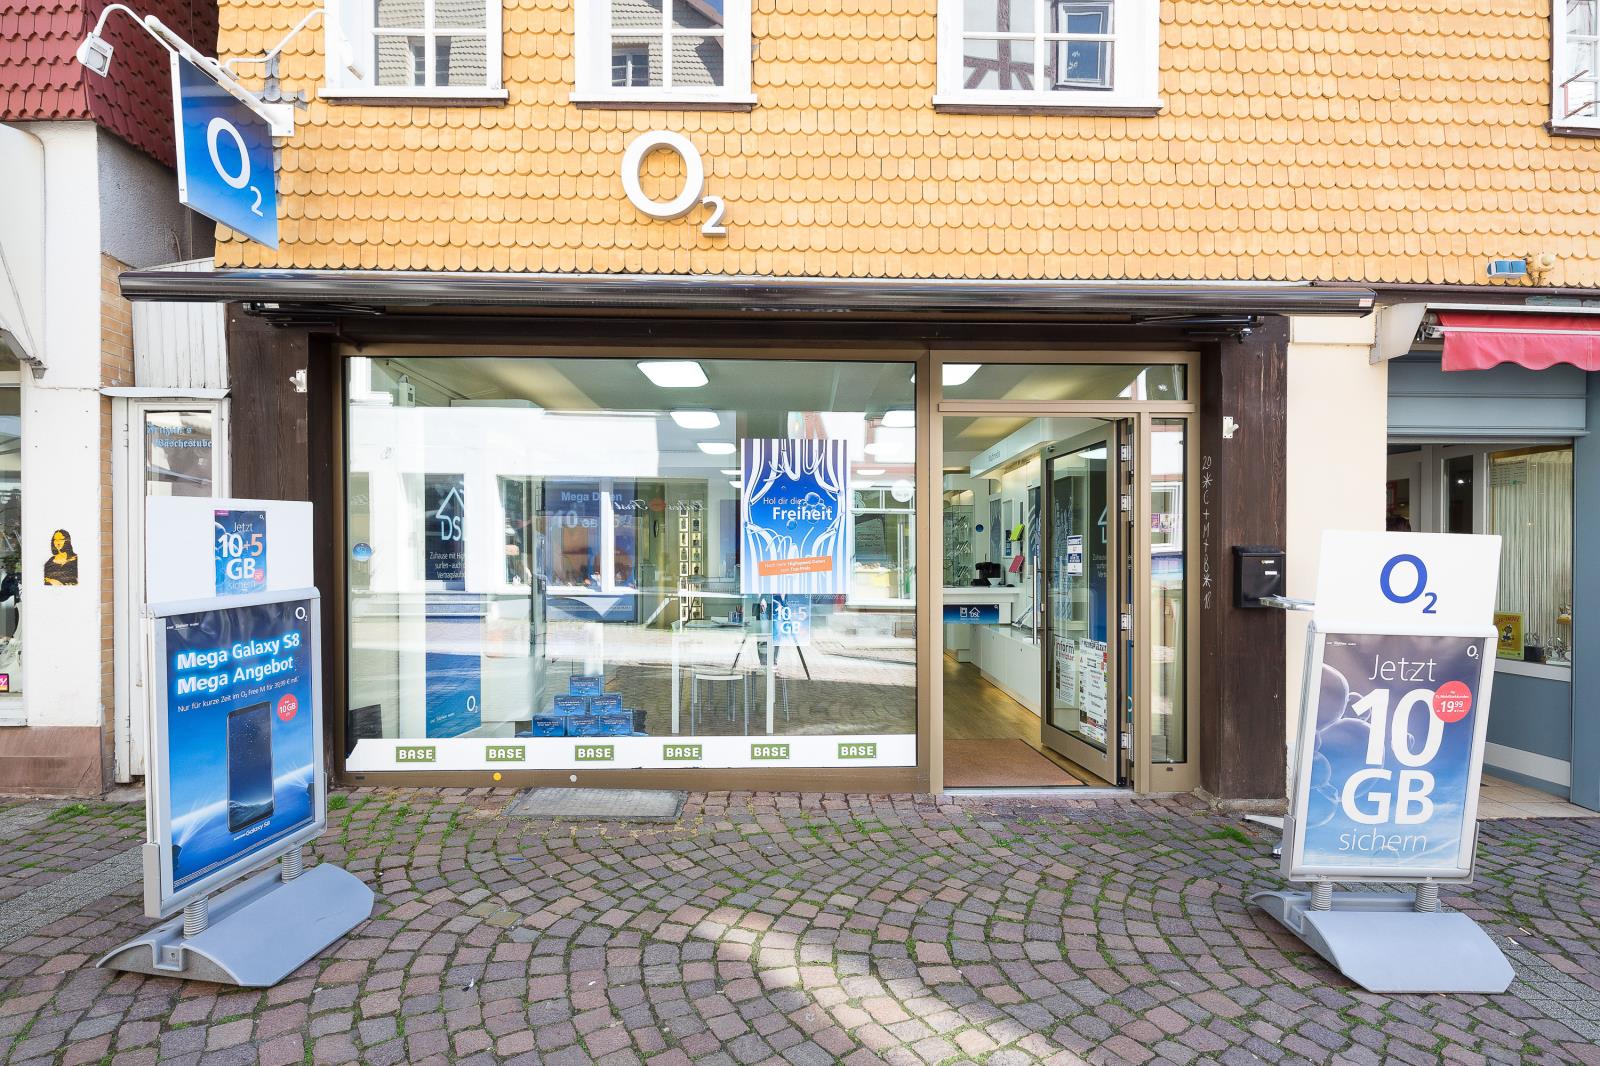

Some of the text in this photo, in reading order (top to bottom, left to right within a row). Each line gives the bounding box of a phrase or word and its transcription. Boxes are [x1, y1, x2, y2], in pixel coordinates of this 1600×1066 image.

[207, 117, 264, 217] O2
[621, 129, 727, 237] O2
[561, 491, 589, 502] Mega
[763, 497, 776, 505] Hol
[778, 497, 788, 505] dir
[772, 506, 832, 520] Freiheit
[233, 522, 253, 533] Jetzt
[226, 558, 256, 580] GB
[1380, 554, 1438, 614] O2
[781, 621, 801, 634] GB
[177, 633, 300, 669] Mega Galaxy S8
[1369, 654, 1437, 682] Jetzt
[177, 657, 293, 694] Mega Angebot
[203, 698, 219, 707] kurze
[280, 702, 296, 714] 10 GB
[1351, 688, 1445, 768] 10
[399, 749, 434, 760] BASE
[489, 748, 523, 759] BASE
[578, 747, 612, 758] BASE
[666, 747, 700, 758] BASE
[754, 746, 788, 757] BASE
[841, 745, 875, 757] BASE
[1341, 768, 1435, 825] GB
[1338, 827, 1427, 852] sichern
